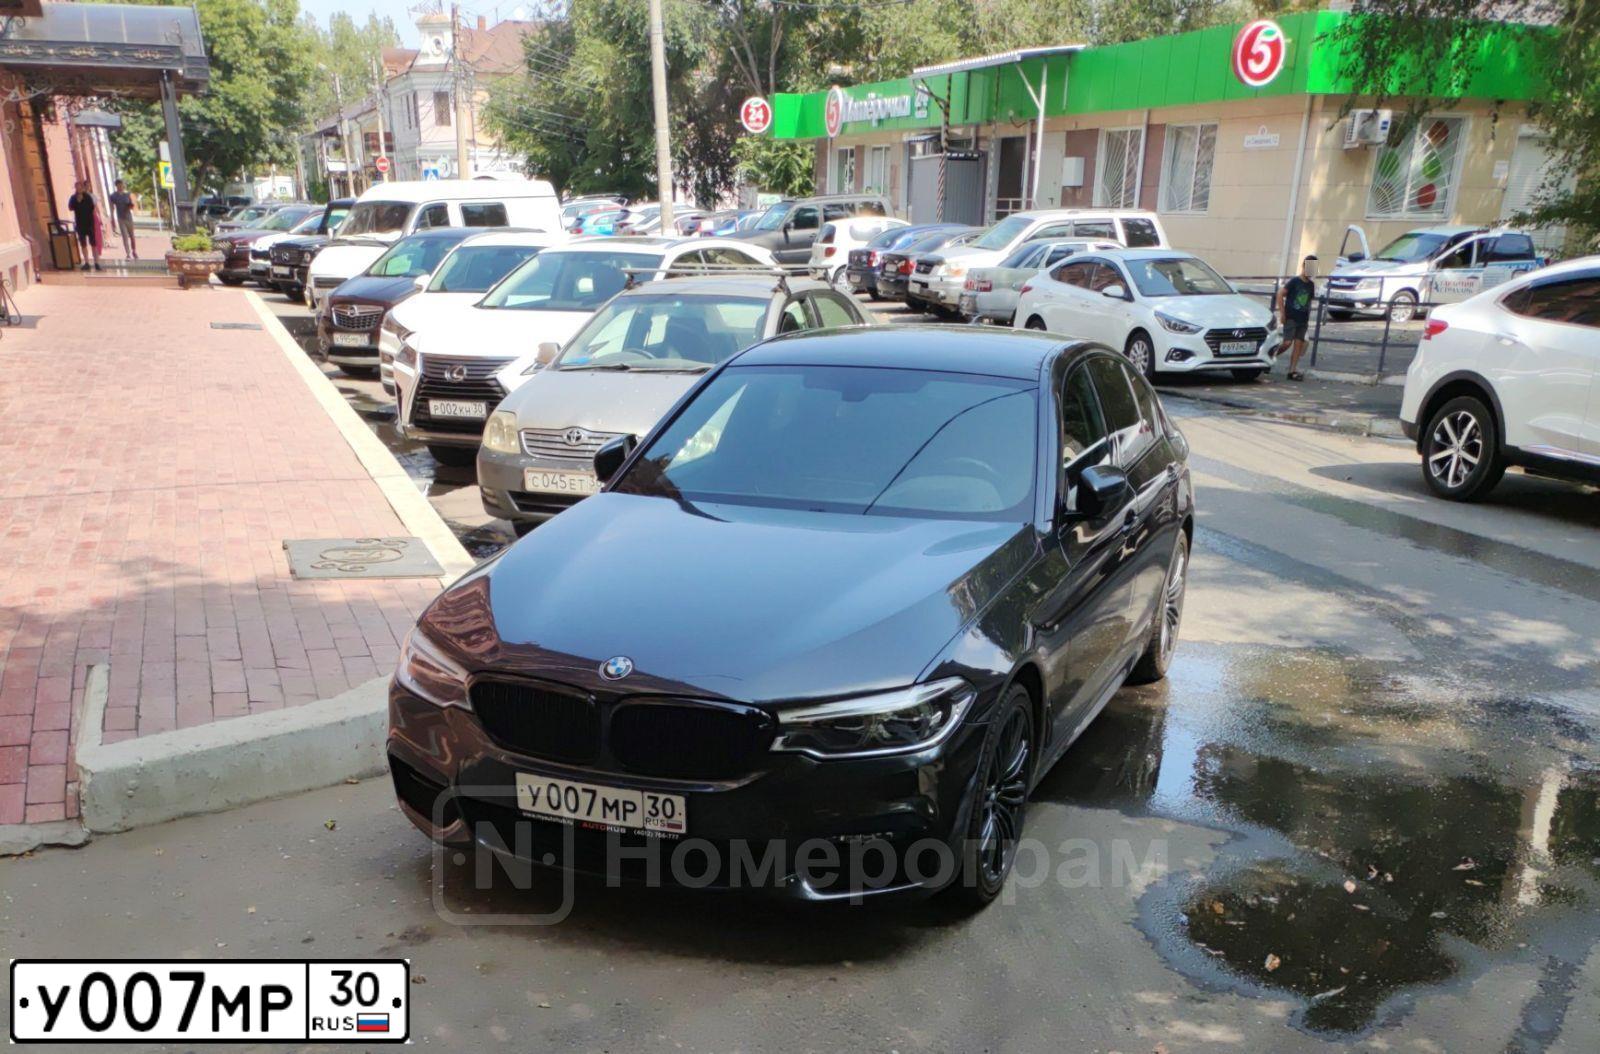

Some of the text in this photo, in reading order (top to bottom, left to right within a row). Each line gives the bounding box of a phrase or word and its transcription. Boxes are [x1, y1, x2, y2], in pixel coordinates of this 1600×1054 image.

[1247, 27, 1278, 74] 5
[748, 107, 764, 122] 24
[531, 473, 585, 491] С045ЕТ
[528, 782, 675, 822] У007МР 30
[645, 817, 666, 828] RUS
